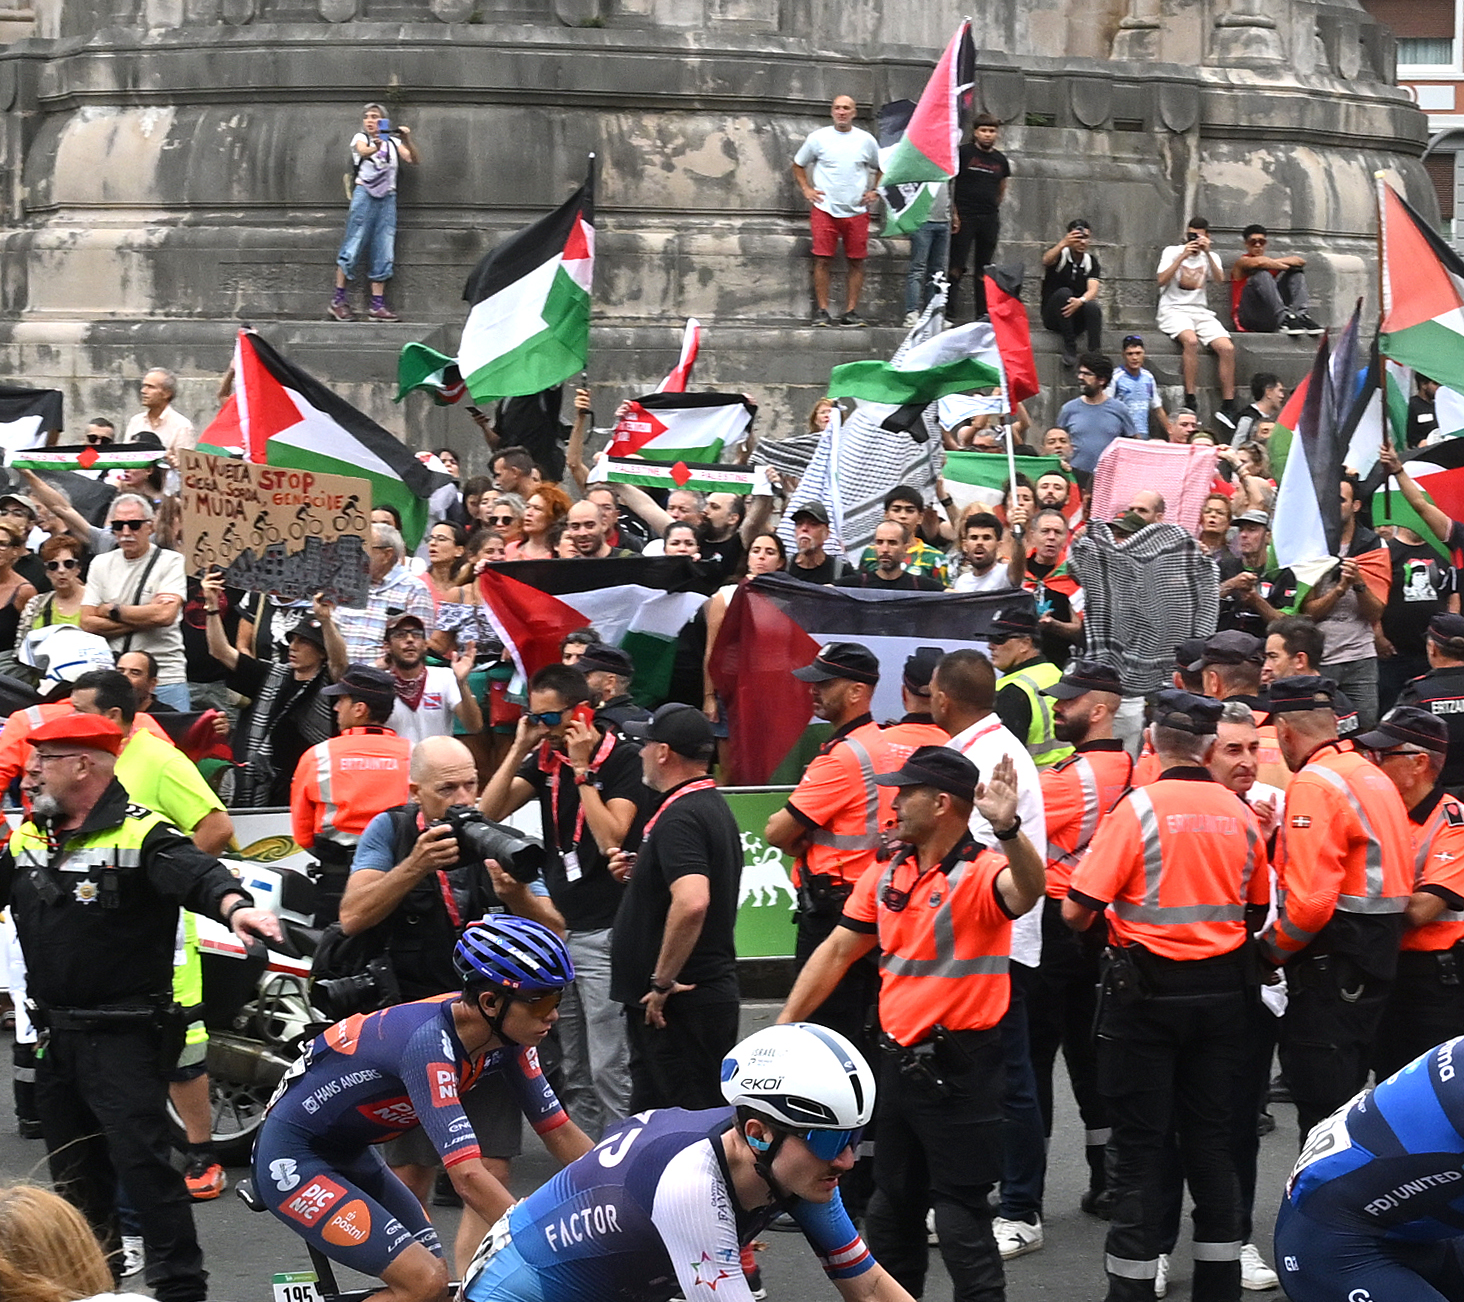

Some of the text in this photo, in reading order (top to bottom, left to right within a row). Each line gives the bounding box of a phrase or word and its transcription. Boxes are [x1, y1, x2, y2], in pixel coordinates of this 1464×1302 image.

[185, 456, 202, 471] LA
[615, 465, 749, 483] PALESTINE PALESTINE
[258, 470, 315, 495] STOP
[196, 494, 249, 522] MUDA
[340, 758, 400, 771] ERTZAINTZA
[313, 1069, 383, 1105] HANS ANDERS
[437, 1070, 457, 1085] PI
[304, 1183, 335, 1209] PIC
[1364, 1169, 1463, 1218] FDJ UNITED
[332, 1215, 367, 1241] postnl
[544, 1202, 623, 1253] FACTOR
